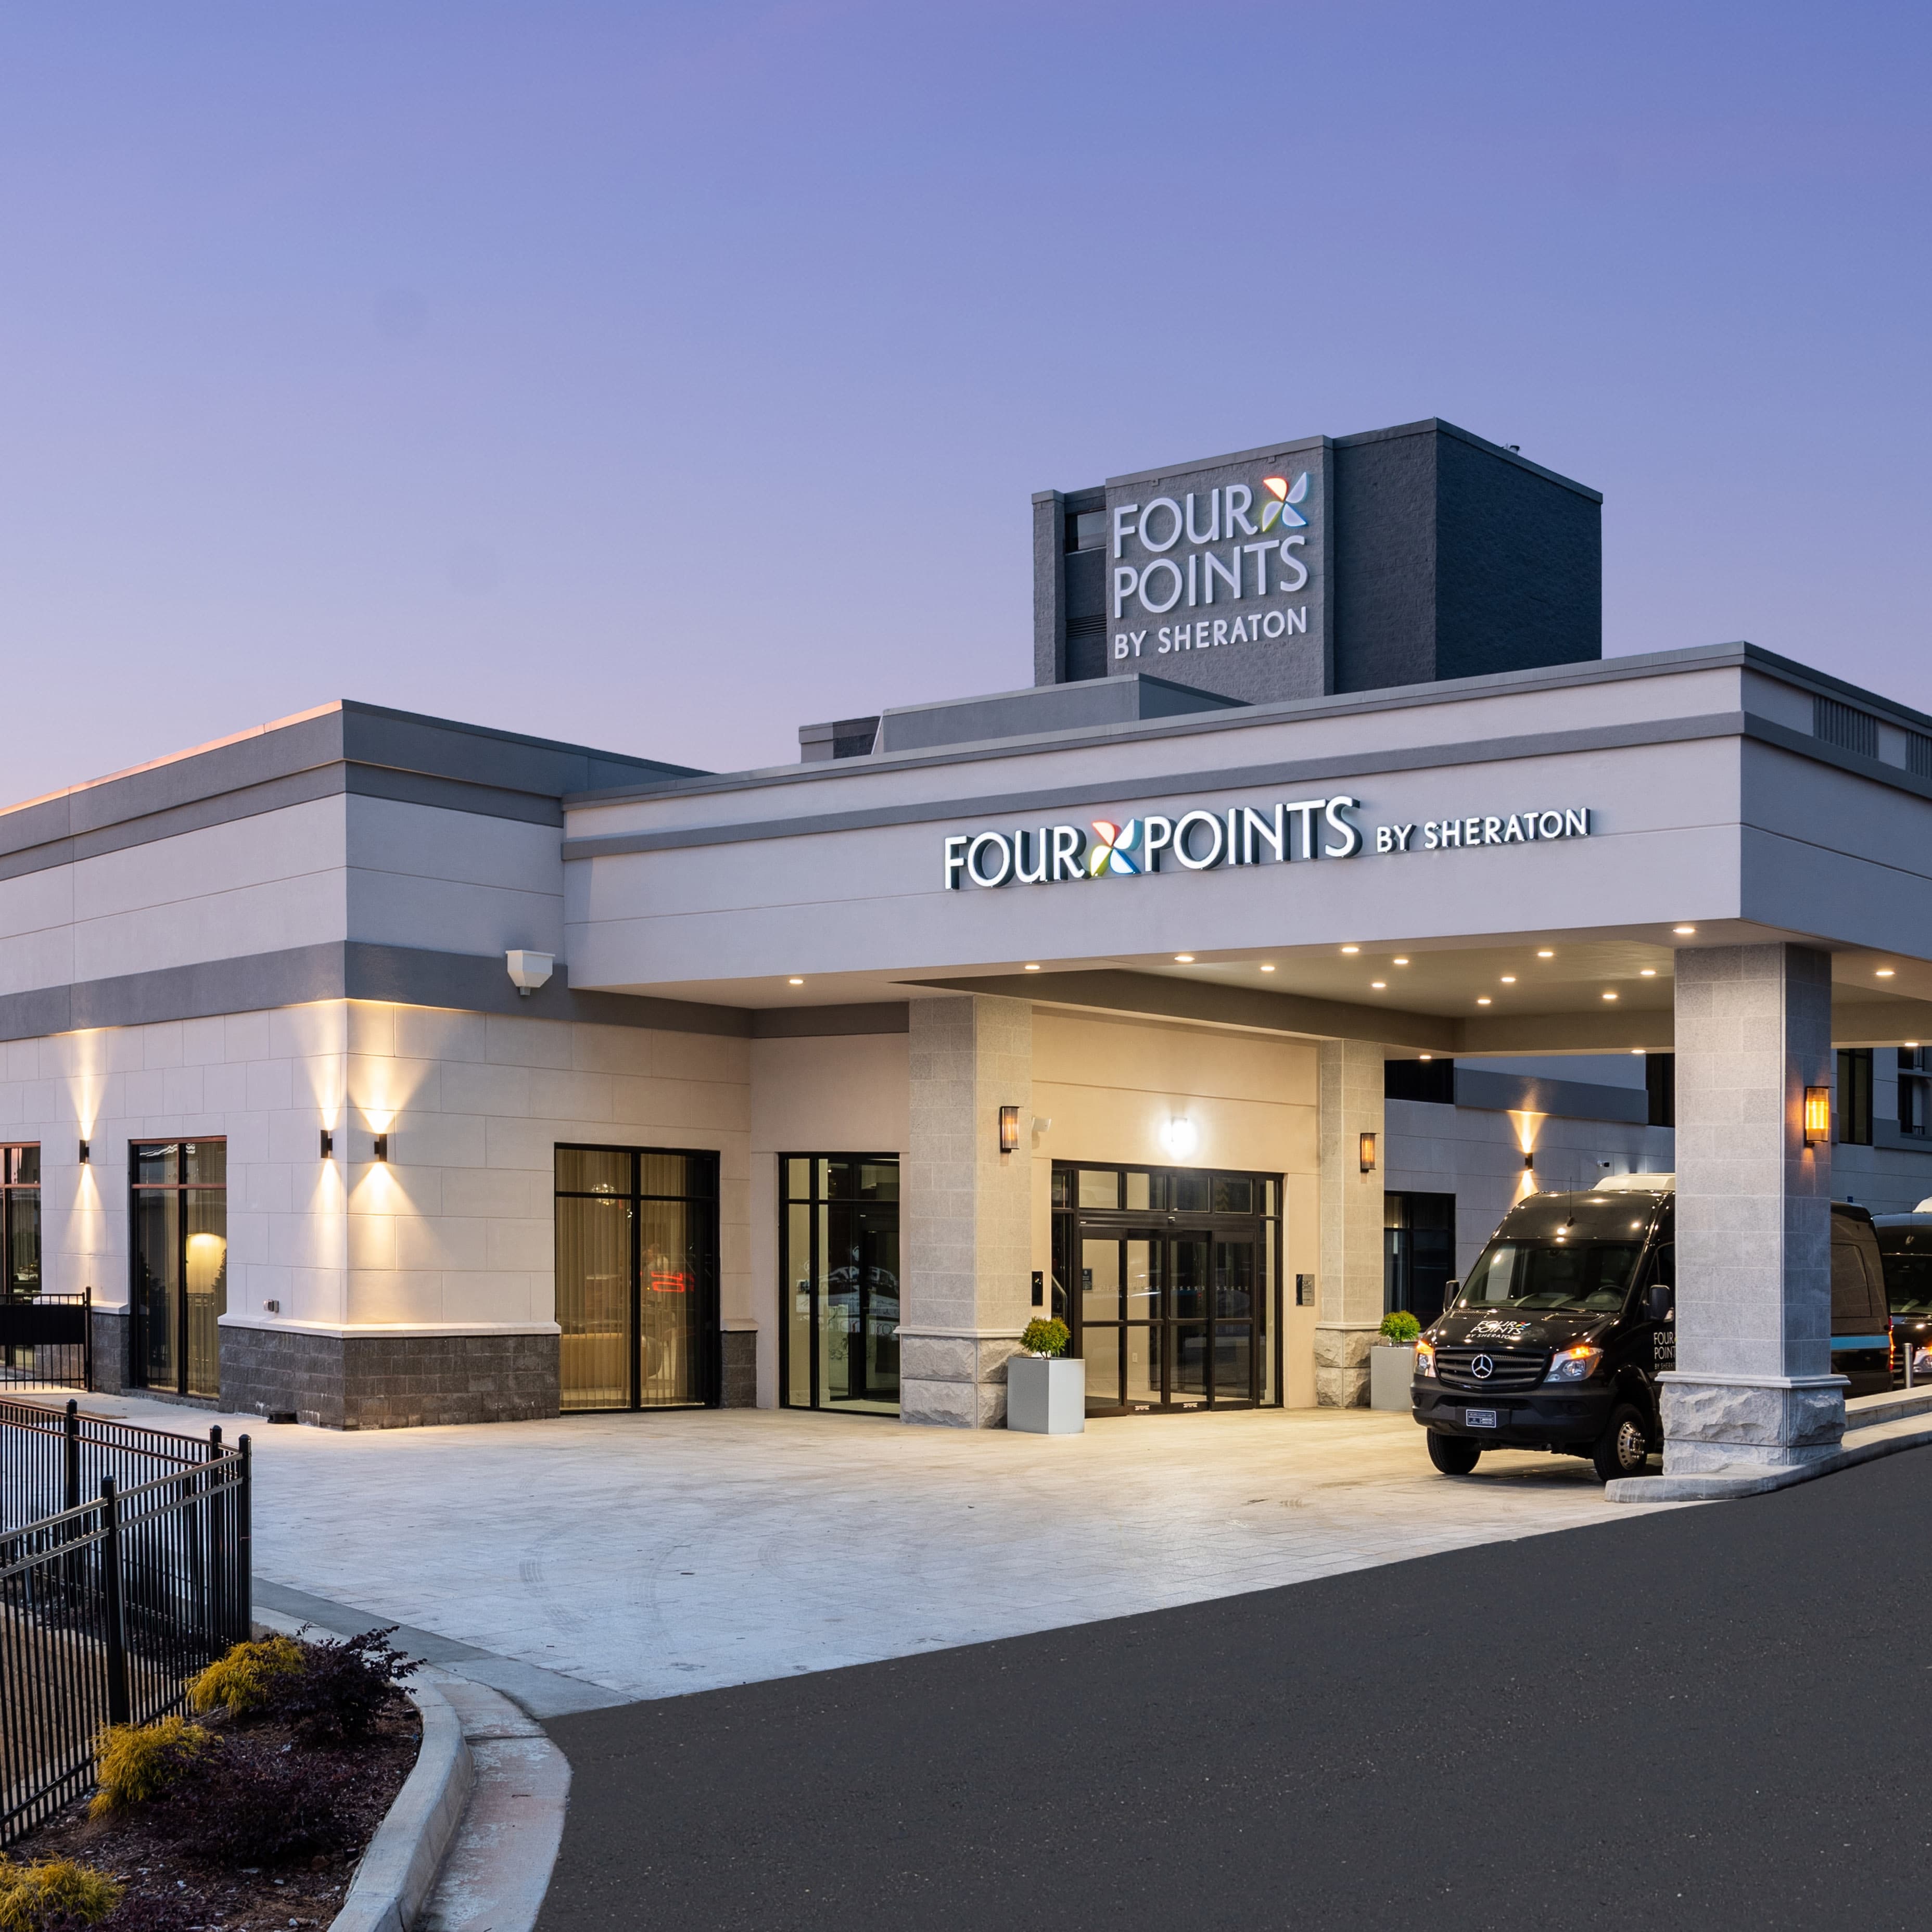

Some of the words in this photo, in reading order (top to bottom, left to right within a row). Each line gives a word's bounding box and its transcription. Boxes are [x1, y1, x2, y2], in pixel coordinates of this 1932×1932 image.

[1114, 484, 1259, 558] FOUR
[1114, 535, 1309, 618] POINTS
[1114, 629, 1148, 659] BY
[1157, 605, 1307, 654] SHERATON
[945, 824, 1090, 890] FOUR
[1144, 795, 1362, 873] POINTS
[1376, 823, 1415, 853] BY
[1423, 807, 1591, 849] SHERATON
[1470, 1326, 1524, 1335] POINTS
[1654, 1331, 1674, 1345] FOUR
[1654, 1346, 1676, 1359] POINT
